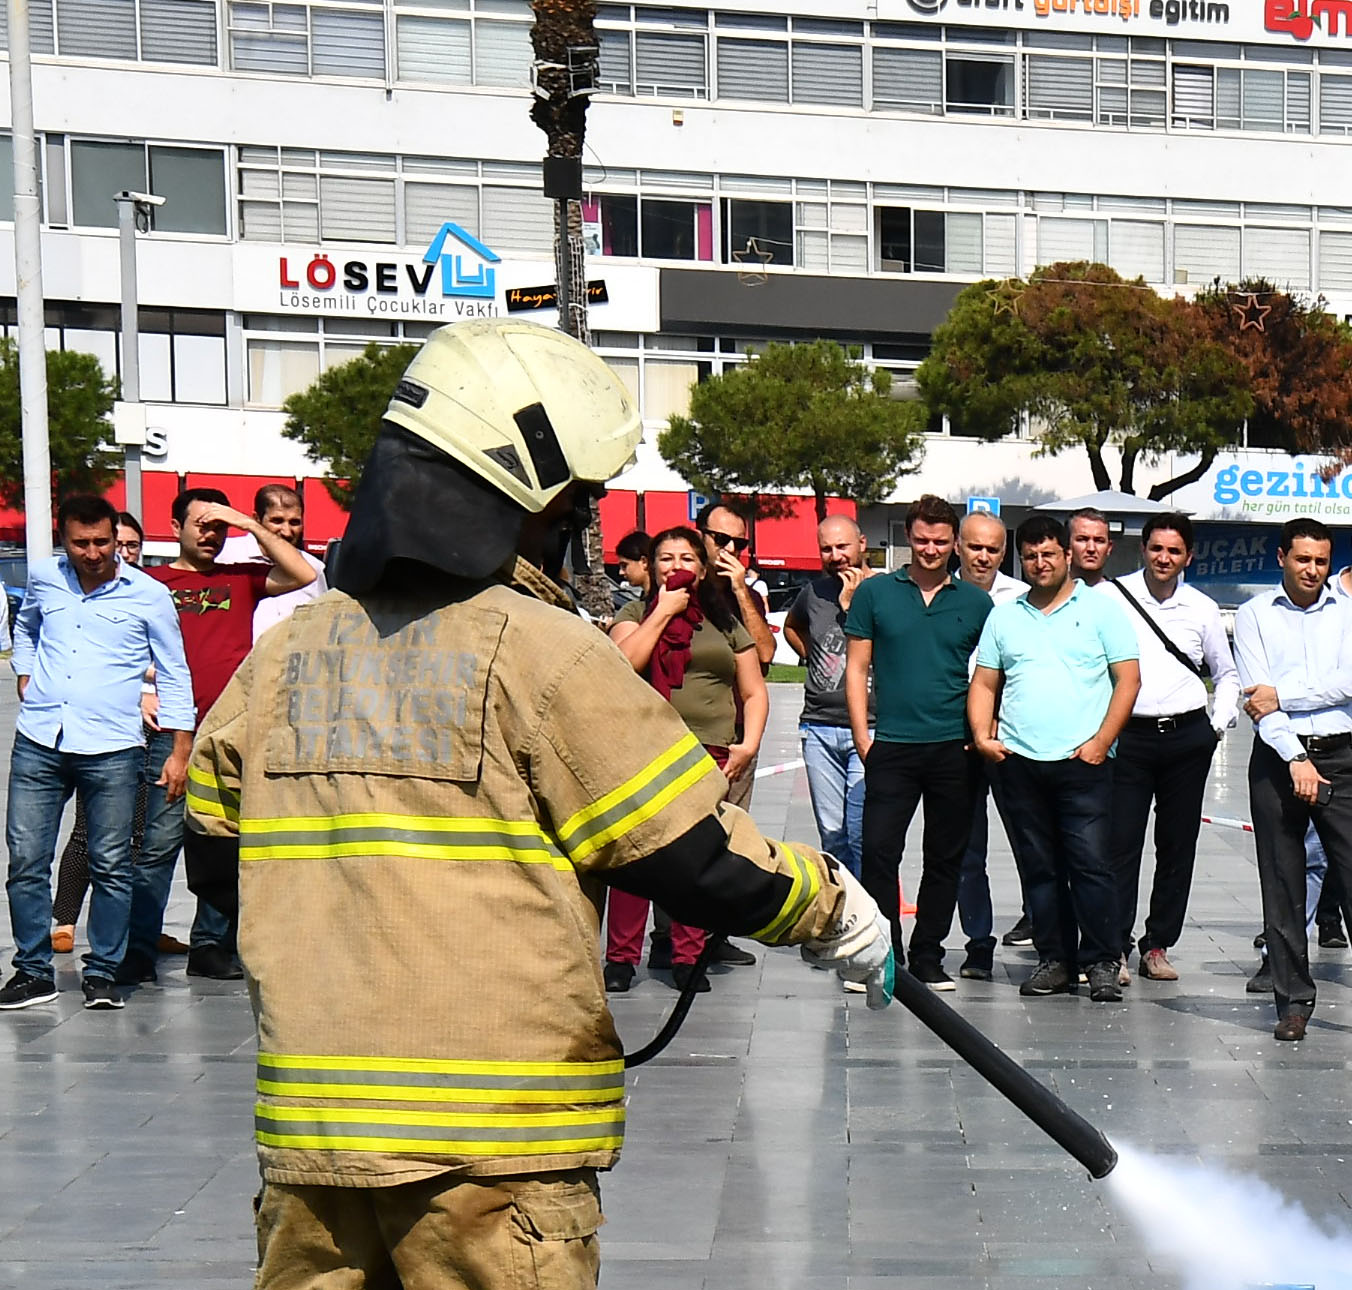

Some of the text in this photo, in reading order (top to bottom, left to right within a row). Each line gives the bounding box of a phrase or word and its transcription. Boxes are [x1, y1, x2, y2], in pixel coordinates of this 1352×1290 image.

[279, 253, 435, 294] LÖSEV
[280, 291, 356, 310] Lösemili
[367, 296, 446, 315] Çocuklar
[691, 491, 709, 519] P
[1242, 499, 1264, 513] her
[1266, 501, 1291, 516] gün
[1294, 502, 1321, 514] tatil
[1192, 536, 1268, 561] UÇAK
